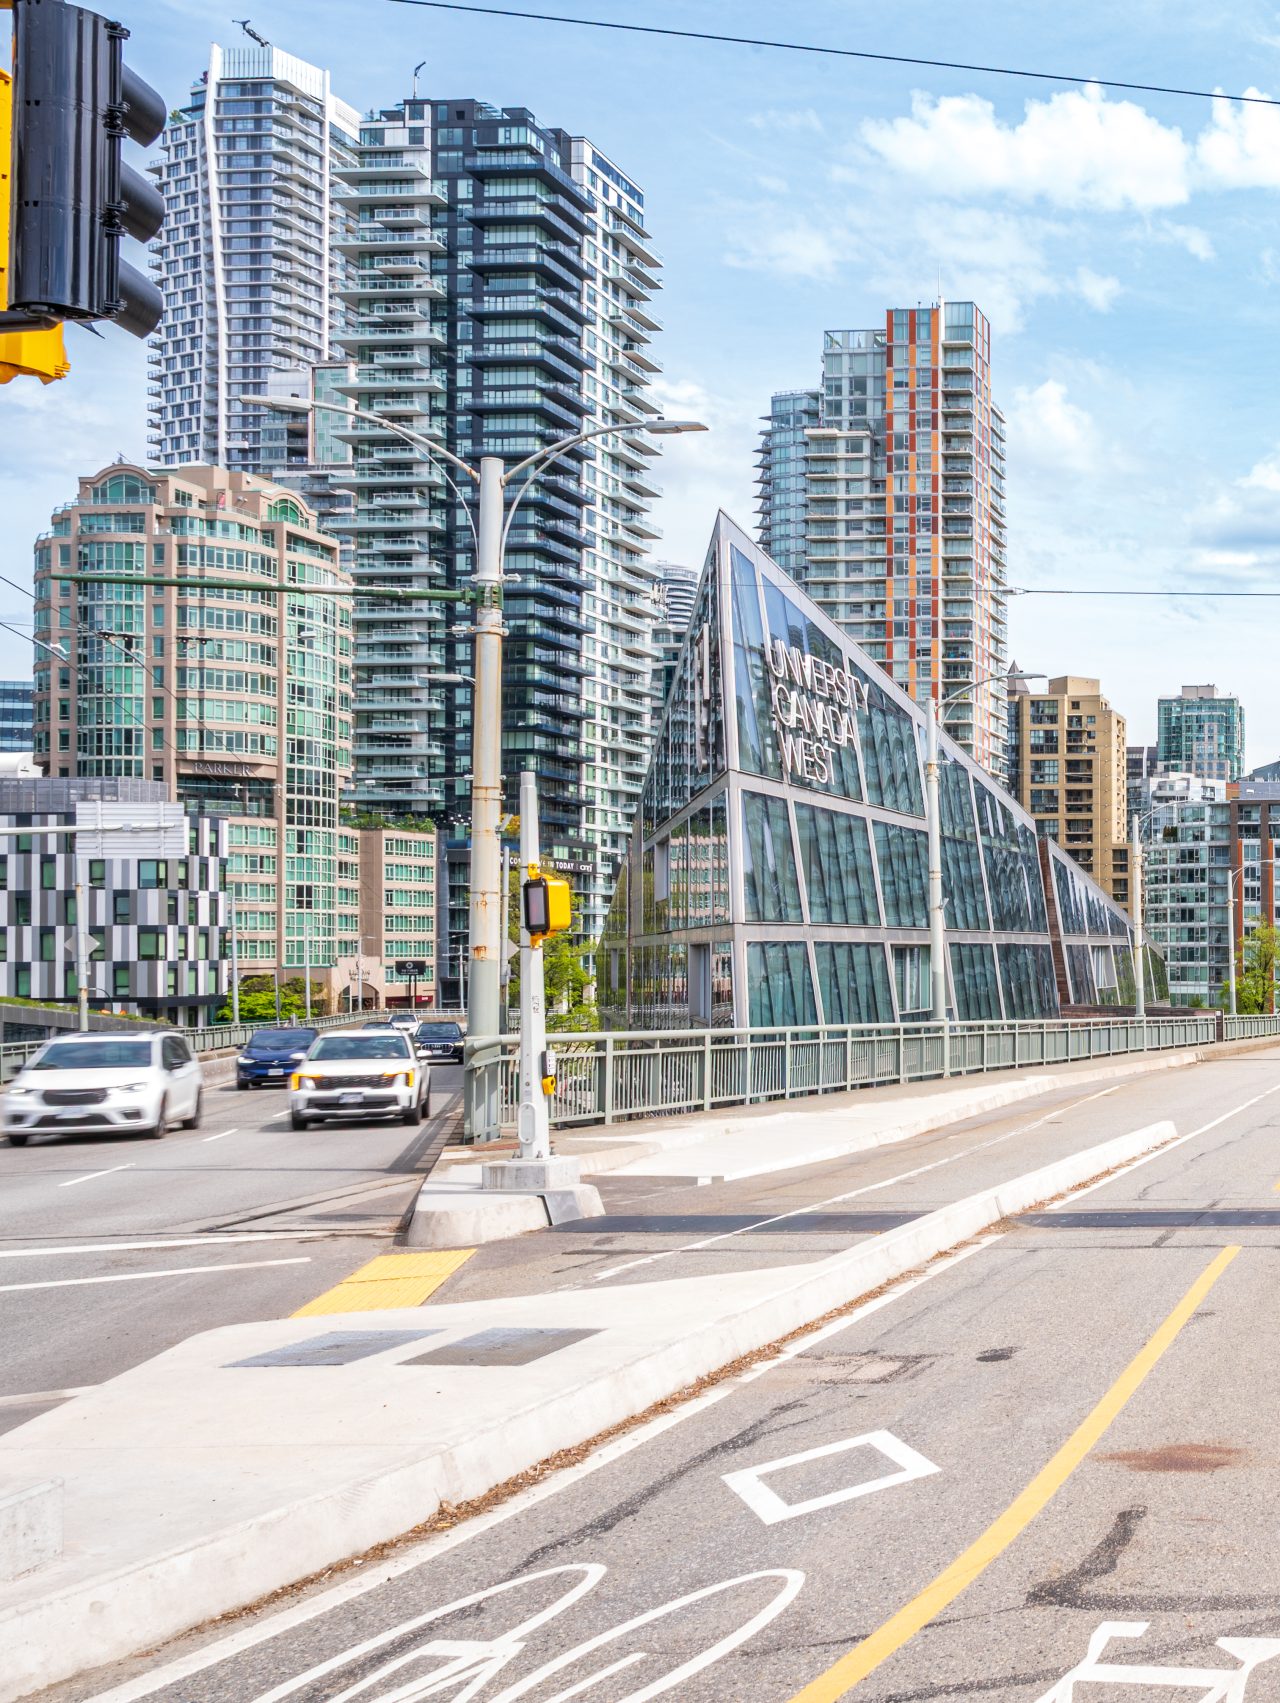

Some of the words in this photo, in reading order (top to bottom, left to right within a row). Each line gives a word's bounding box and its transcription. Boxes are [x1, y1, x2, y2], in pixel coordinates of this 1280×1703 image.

[768, 639, 869, 715] UNIVERSITY
[773, 683, 855, 747] CANADA
[777, 729, 835, 786] WEST
[556, 860, 574, 870] TODAY
